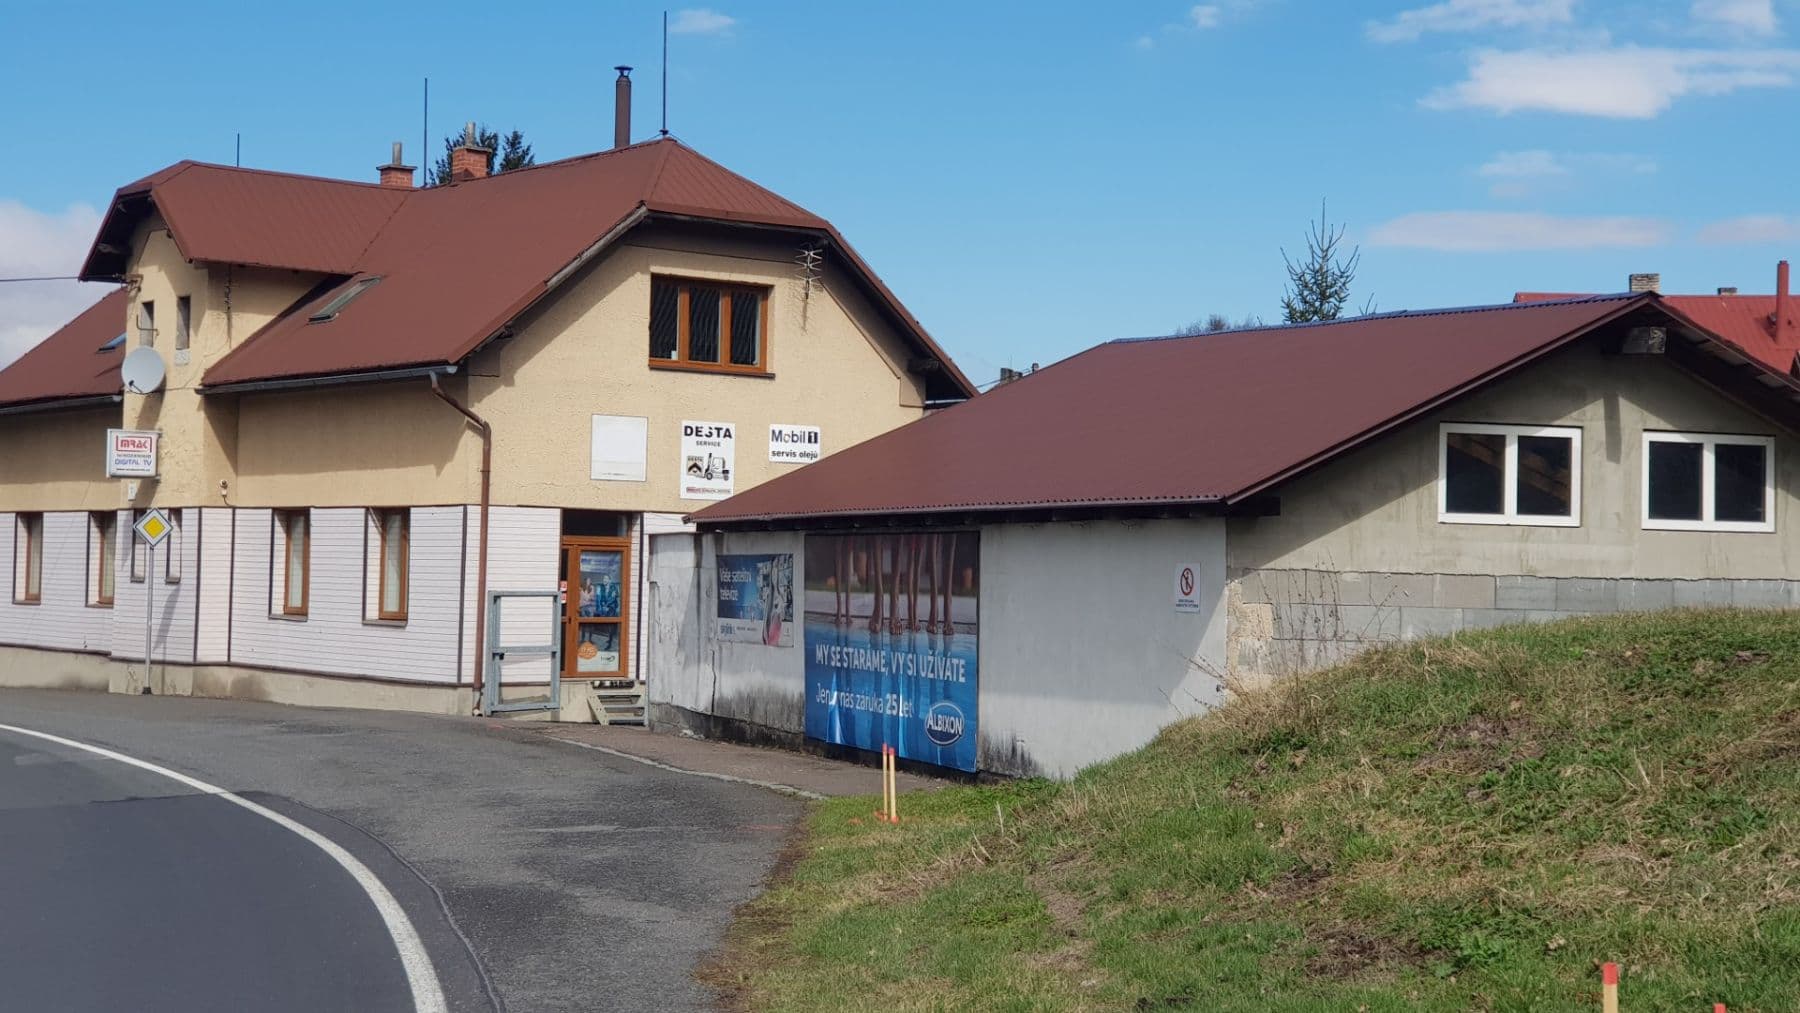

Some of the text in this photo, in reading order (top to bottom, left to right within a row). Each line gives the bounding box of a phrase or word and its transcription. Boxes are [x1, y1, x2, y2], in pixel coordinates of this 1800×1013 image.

[684, 425, 733, 439] DESTA
[771, 429, 806, 443] Mobil
[696, 440, 721, 448] SERVICE
[816, 644, 829, 665] MY
[830, 645, 841, 667] SE
[891, 652, 905, 675] VY
[907, 653, 917, 677] SI
[919, 649, 966, 683] UŽÍVÁTE
[815, 683, 830, 704] Jen
[840, 689, 854, 709] nás
[856, 690, 883, 713] záruka
[886, 692, 898, 716] 25
[926, 709, 963, 735] ALBIXON
